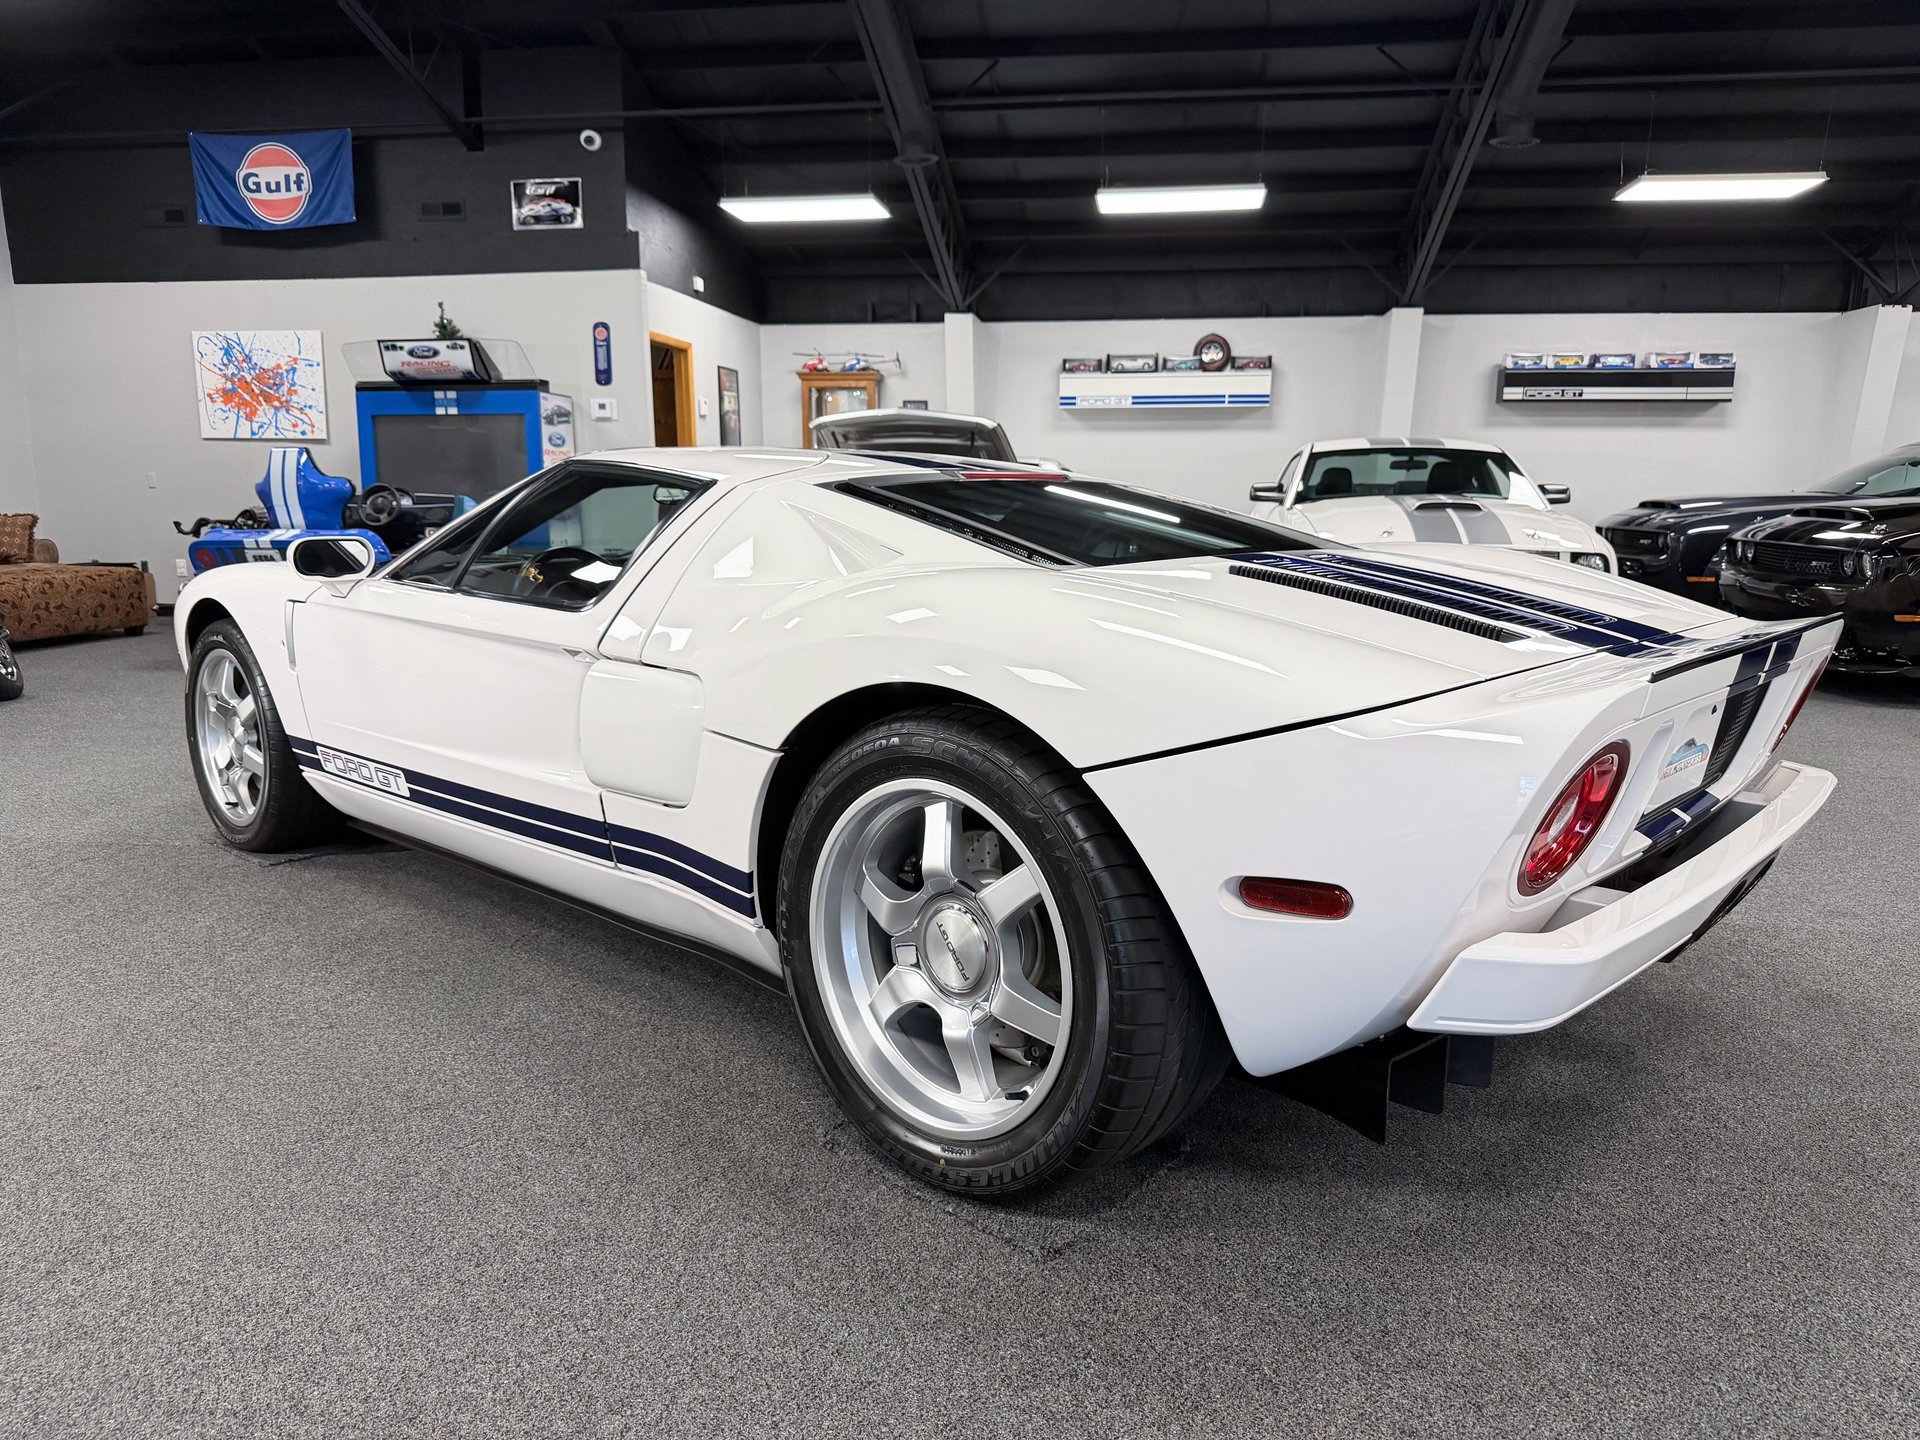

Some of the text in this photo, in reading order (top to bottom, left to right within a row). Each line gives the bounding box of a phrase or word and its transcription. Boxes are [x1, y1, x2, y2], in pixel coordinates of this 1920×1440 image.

[242, 172, 304, 193] Gulf
[412, 346, 434, 357] Ford
[252, 554, 276, 562] SEGA
[320, 749, 401, 791] FORD GT
[936, 921, 970, 982] FORD GT
[862, 1088, 1088, 1187] BRIDGESTONE
